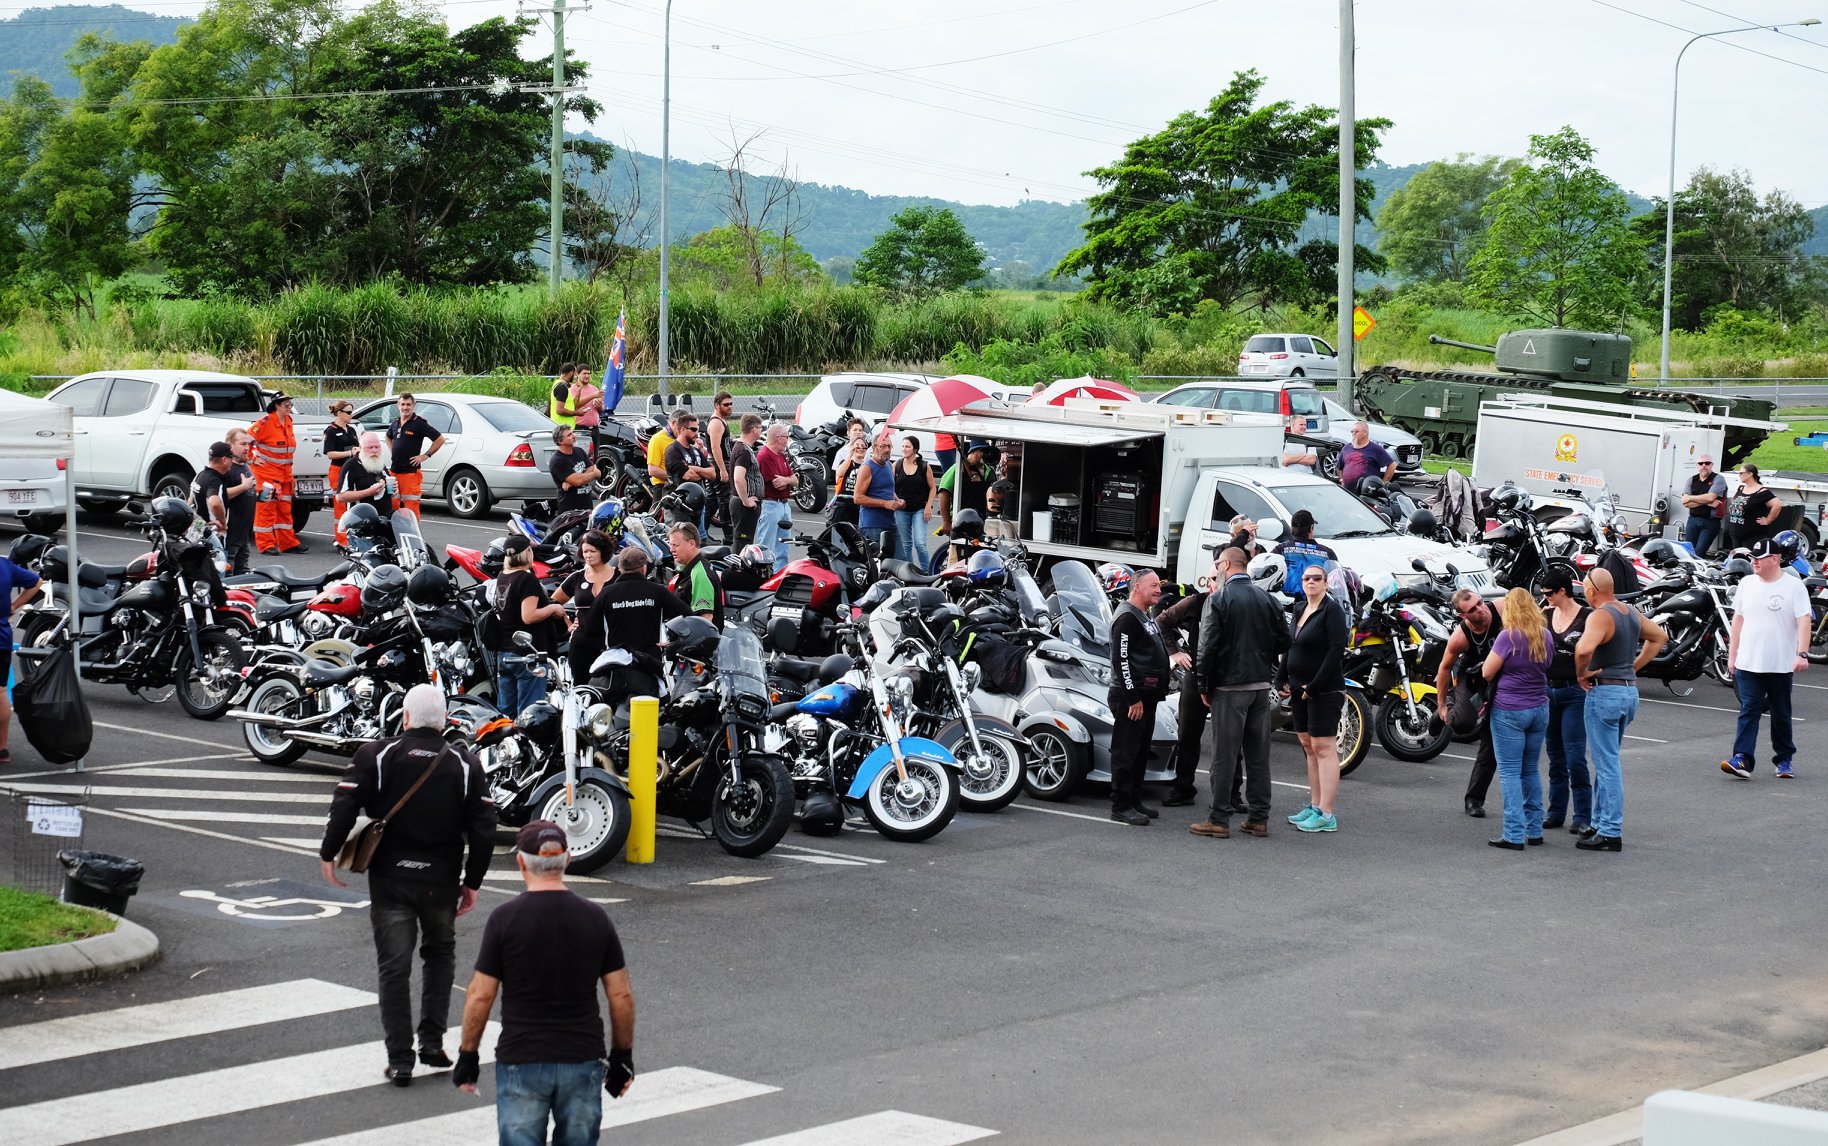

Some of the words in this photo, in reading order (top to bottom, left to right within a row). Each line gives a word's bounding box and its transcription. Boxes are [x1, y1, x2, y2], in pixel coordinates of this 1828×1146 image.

[1525, 469, 1543, 480] STATE
[612, 601, 625, 609] Black
[625, 600, 634, 608] Dog
[1120, 632, 1129, 659] CREW
[1120, 659, 1134, 690] SOCIAL
